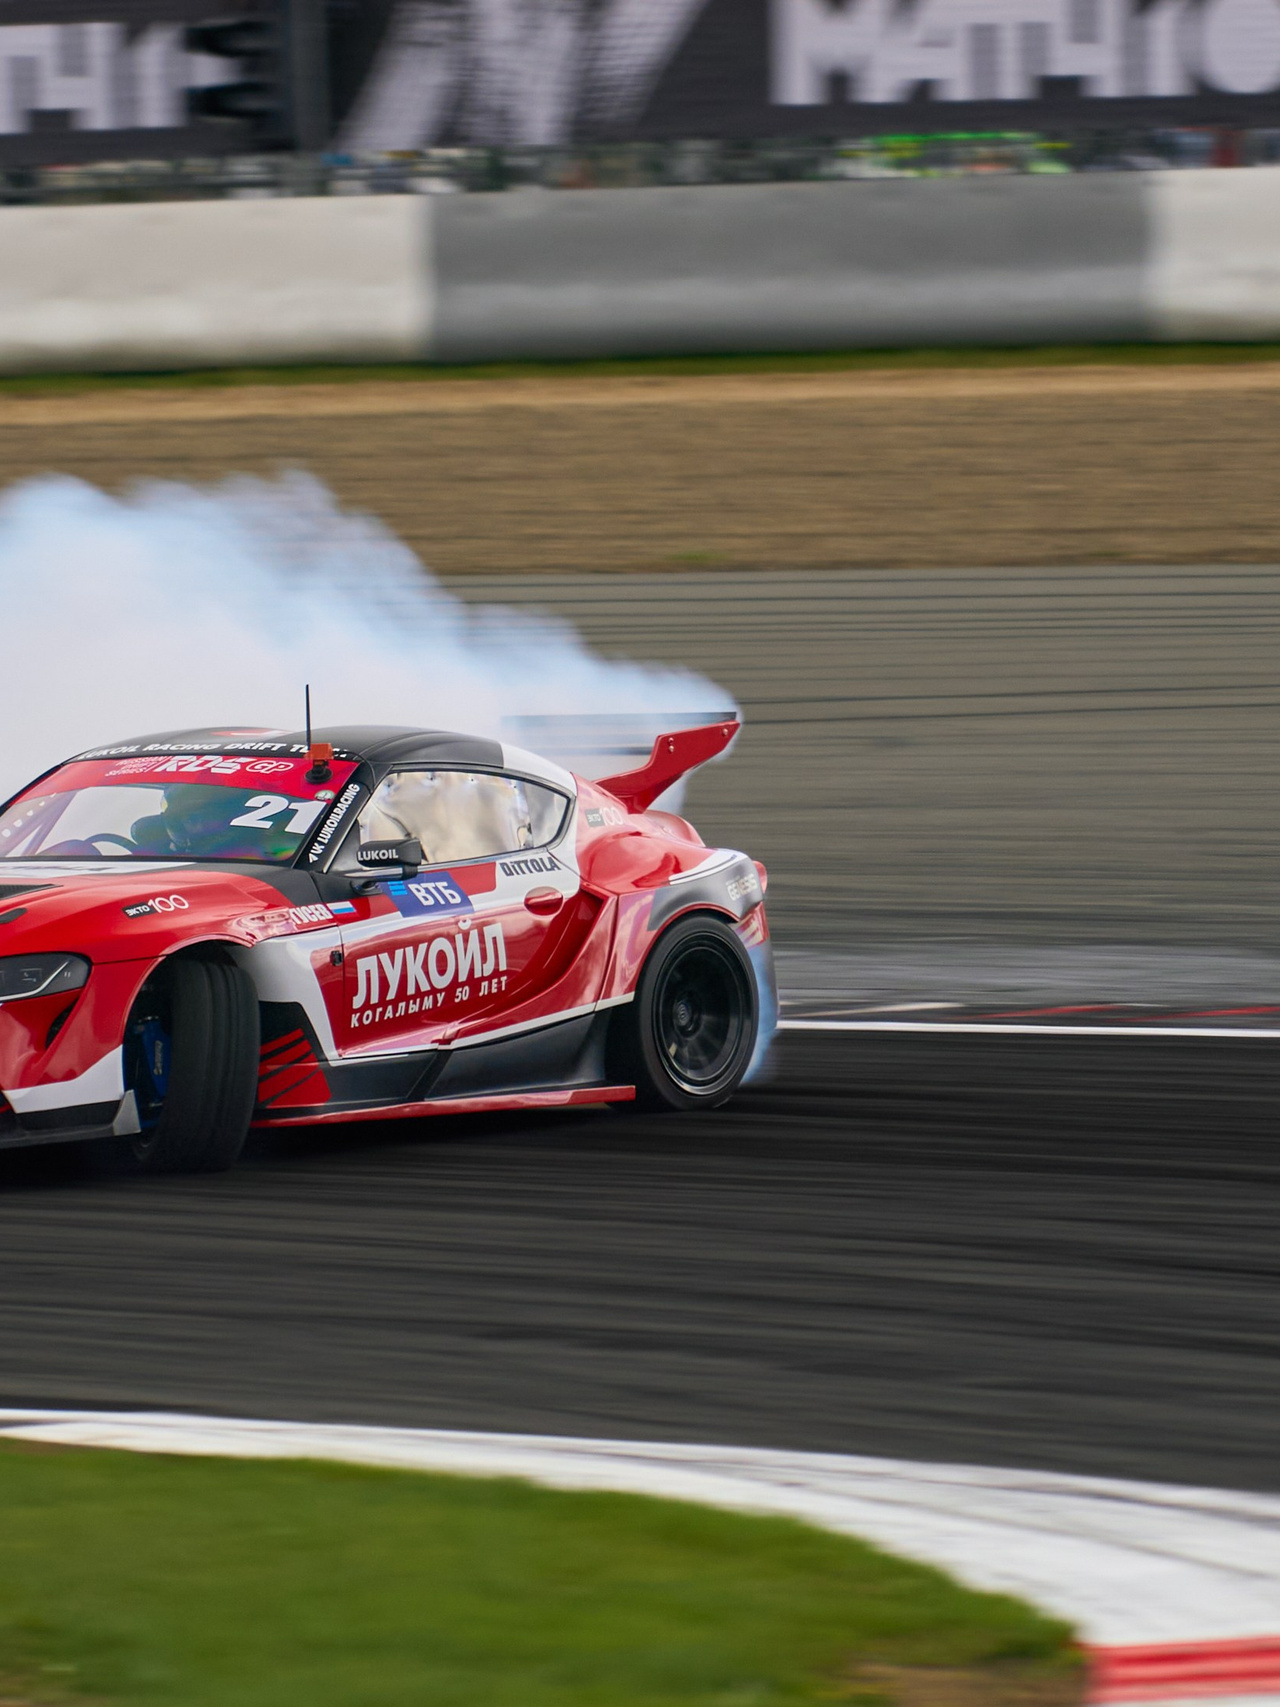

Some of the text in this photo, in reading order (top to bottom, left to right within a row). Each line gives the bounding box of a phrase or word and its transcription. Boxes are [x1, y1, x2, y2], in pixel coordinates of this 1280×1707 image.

[77, 745, 140, 760] LUKOIL
[142, 743, 222, 751] RACING
[224, 742, 287, 751] DRIFT
[153, 755, 257, 774] RDS
[230, 794, 327, 834] 21
[317, 783, 360, 844] LUKOILRACING
[357, 848, 399, 861] LUKOIL
[124, 894, 190, 917] ЭКТО 100
[407, 881, 462, 906] ВТБ
[289, 903, 334, 925] ГУСЕВ
[352, 918, 508, 1010] ЛУКОЙЛ
[350, 975, 508, 1028] КОГАЛЫМУ 50 ЛЕТ
